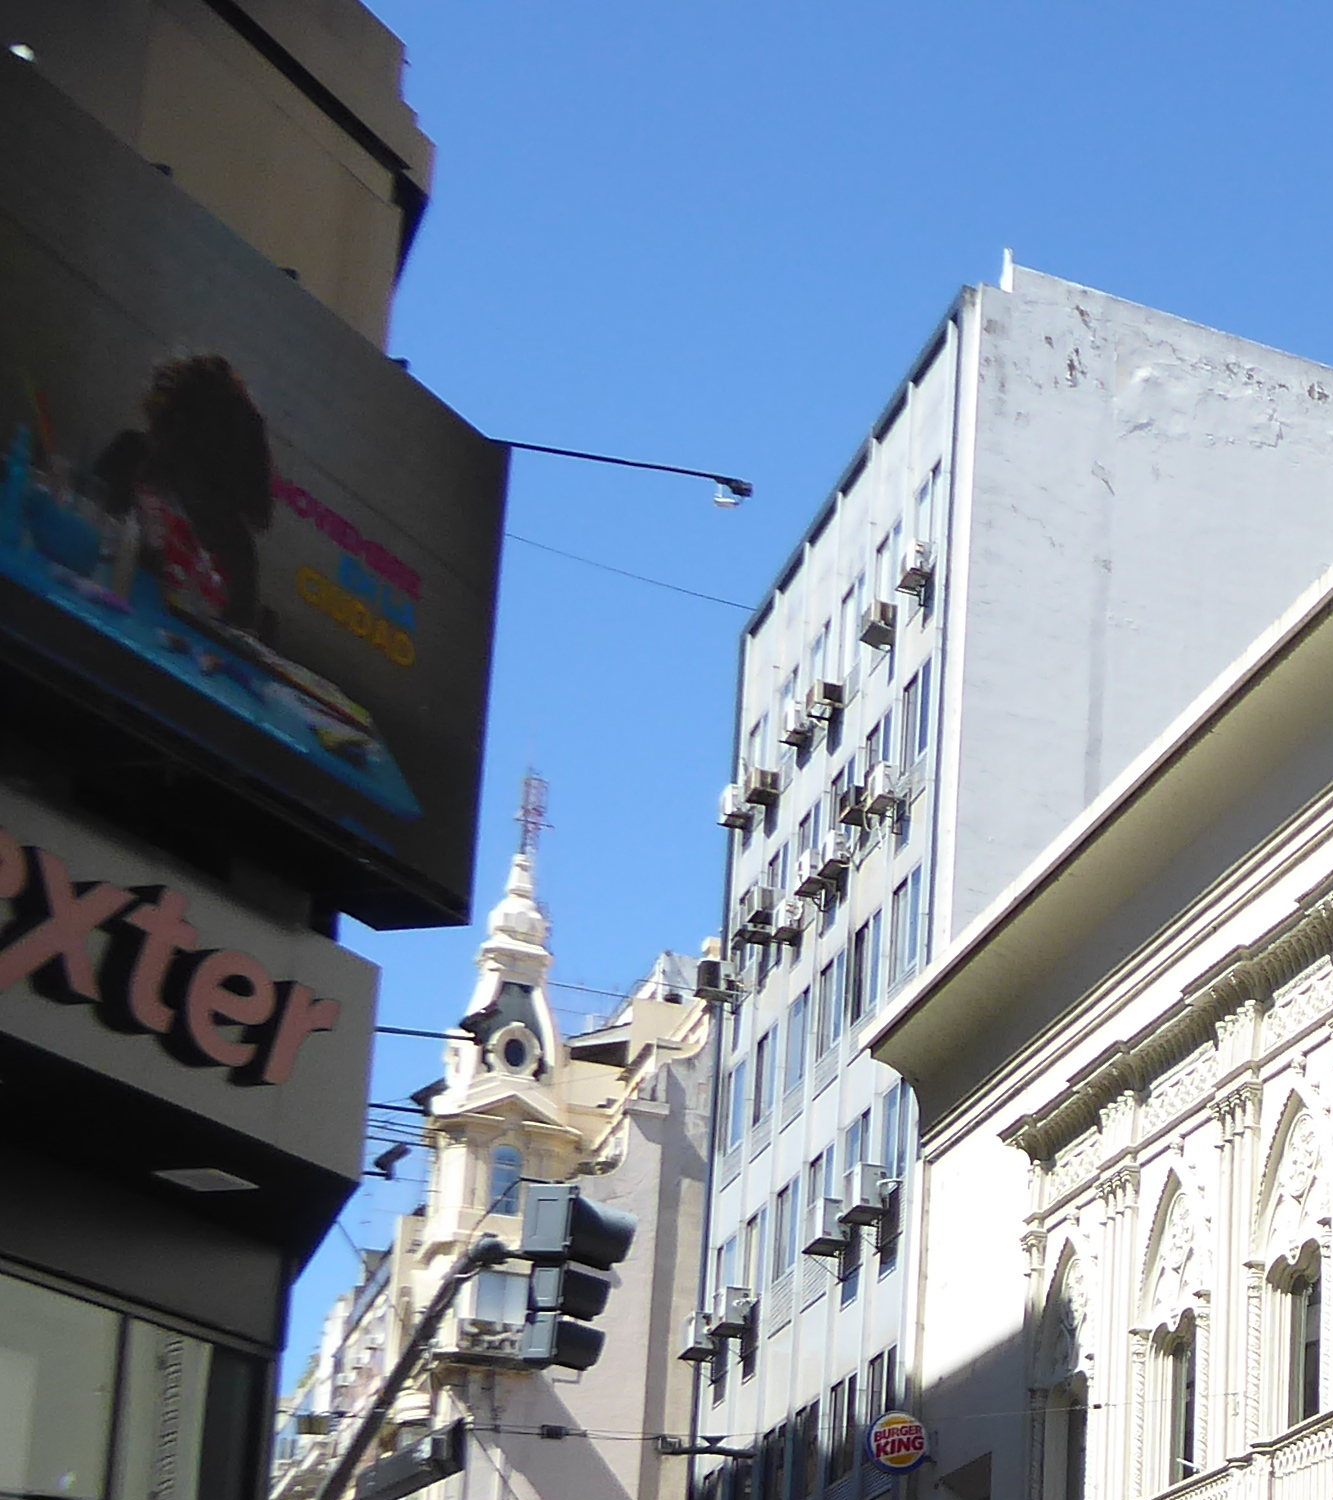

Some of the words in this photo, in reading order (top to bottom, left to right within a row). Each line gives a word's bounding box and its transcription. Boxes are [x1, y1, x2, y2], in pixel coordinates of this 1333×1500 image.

[295, 566, 415, 667] CIUDAD
[873, 1425, 922, 1443] BURGER
[875, 1436, 924, 1459] KING
